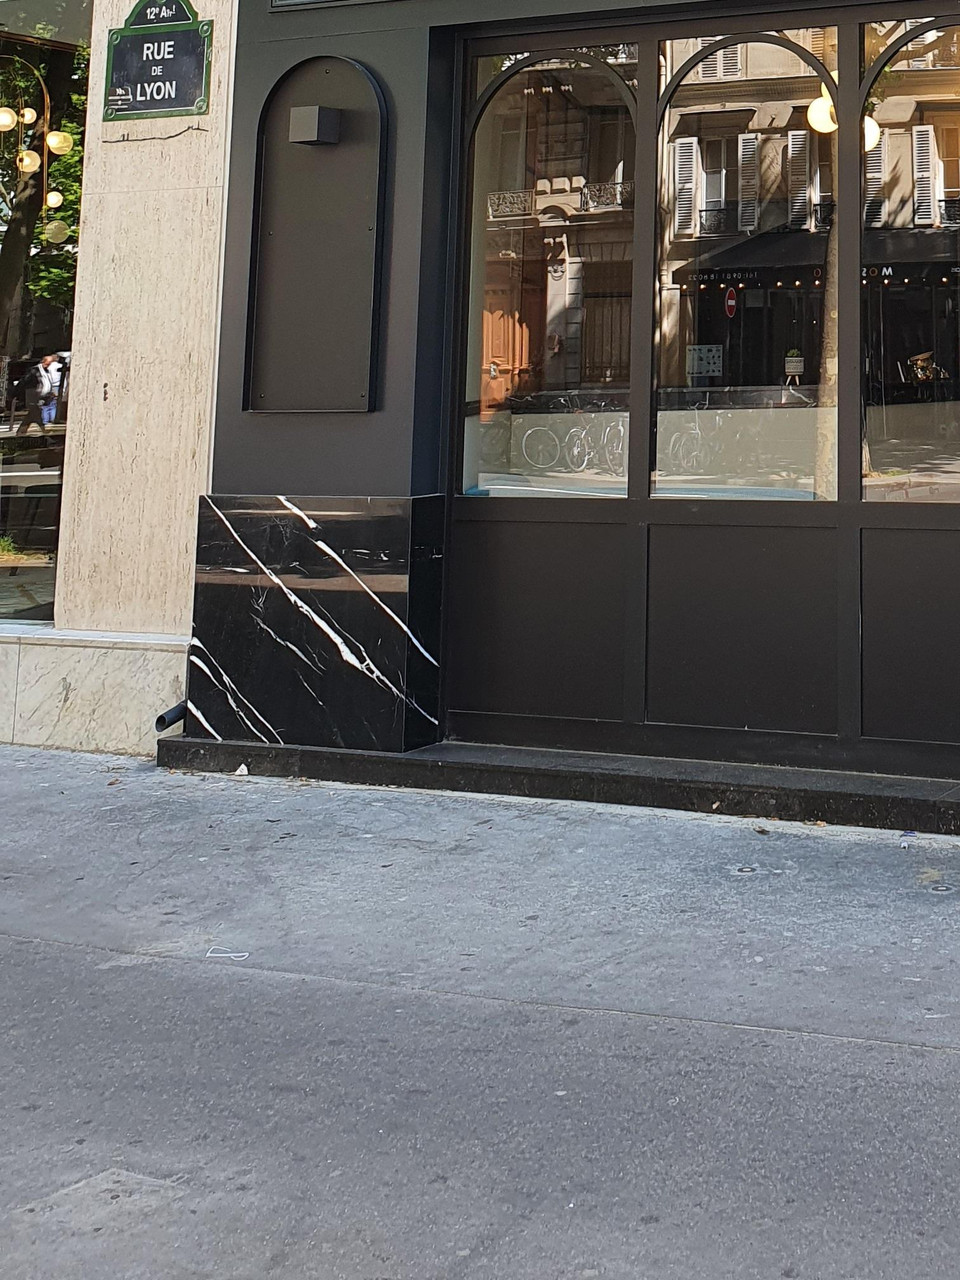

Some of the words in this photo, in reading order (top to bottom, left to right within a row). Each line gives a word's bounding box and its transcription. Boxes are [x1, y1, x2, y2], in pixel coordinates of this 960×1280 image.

[143, 41, 175, 61] RUE
[151, 65, 163, 76] DE
[136, 81, 177, 101] LYON
